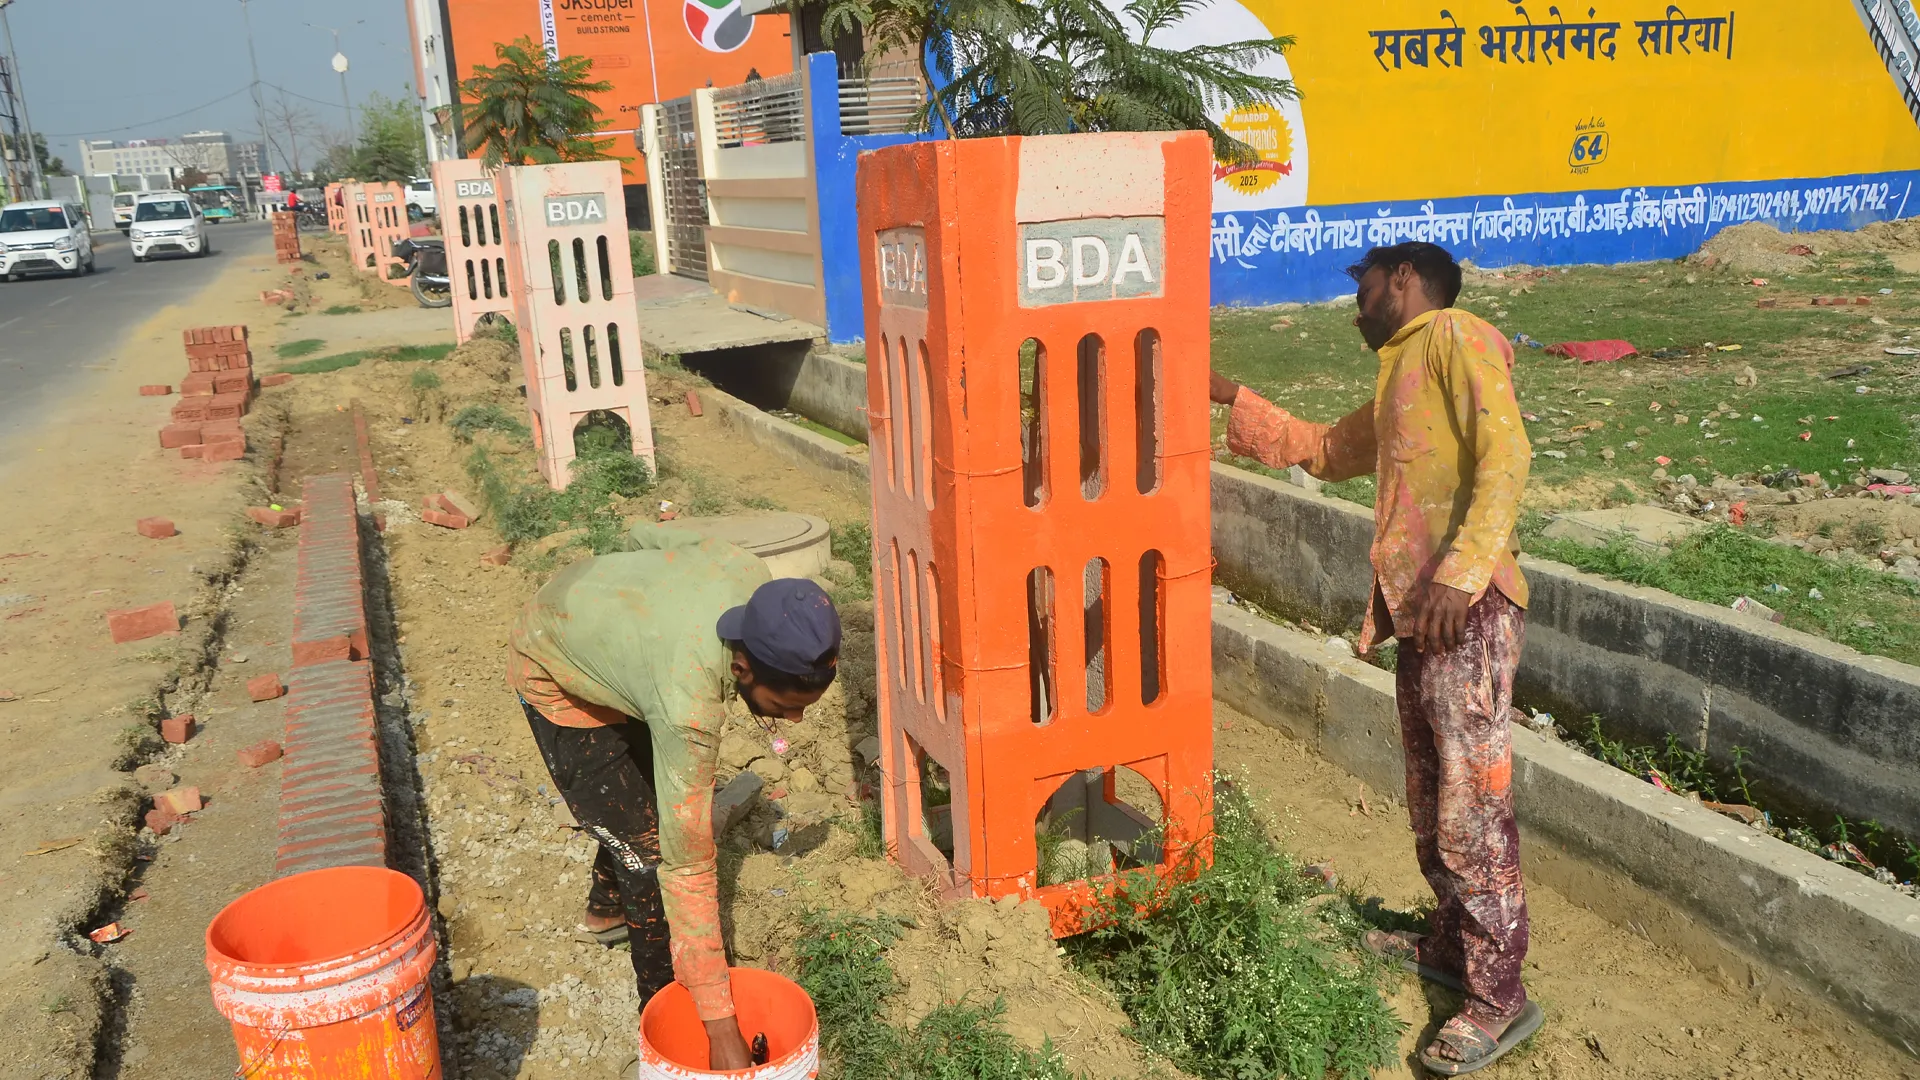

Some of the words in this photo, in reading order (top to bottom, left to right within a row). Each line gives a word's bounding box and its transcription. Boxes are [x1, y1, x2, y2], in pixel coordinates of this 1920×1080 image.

[581, 12, 623, 22] cement
[577, 26, 599, 35] BUILD
[600, 25, 630, 34] STRONG
[1368, 9, 1466, 72] सबसे
[1479, 6, 1621, 66] भरोसेमंद
[1232, 112, 1269, 124] AWARDED
[1574, 134, 1603, 161] 64
[457, 181, 494, 197] BDA
[1239, 175, 1258, 187] 2025
[374, 192, 394, 203] BDA
[548, 199, 602, 222] BDA
[881, 242, 927, 295] BDA
[1026, 232, 1156, 290] BDA
